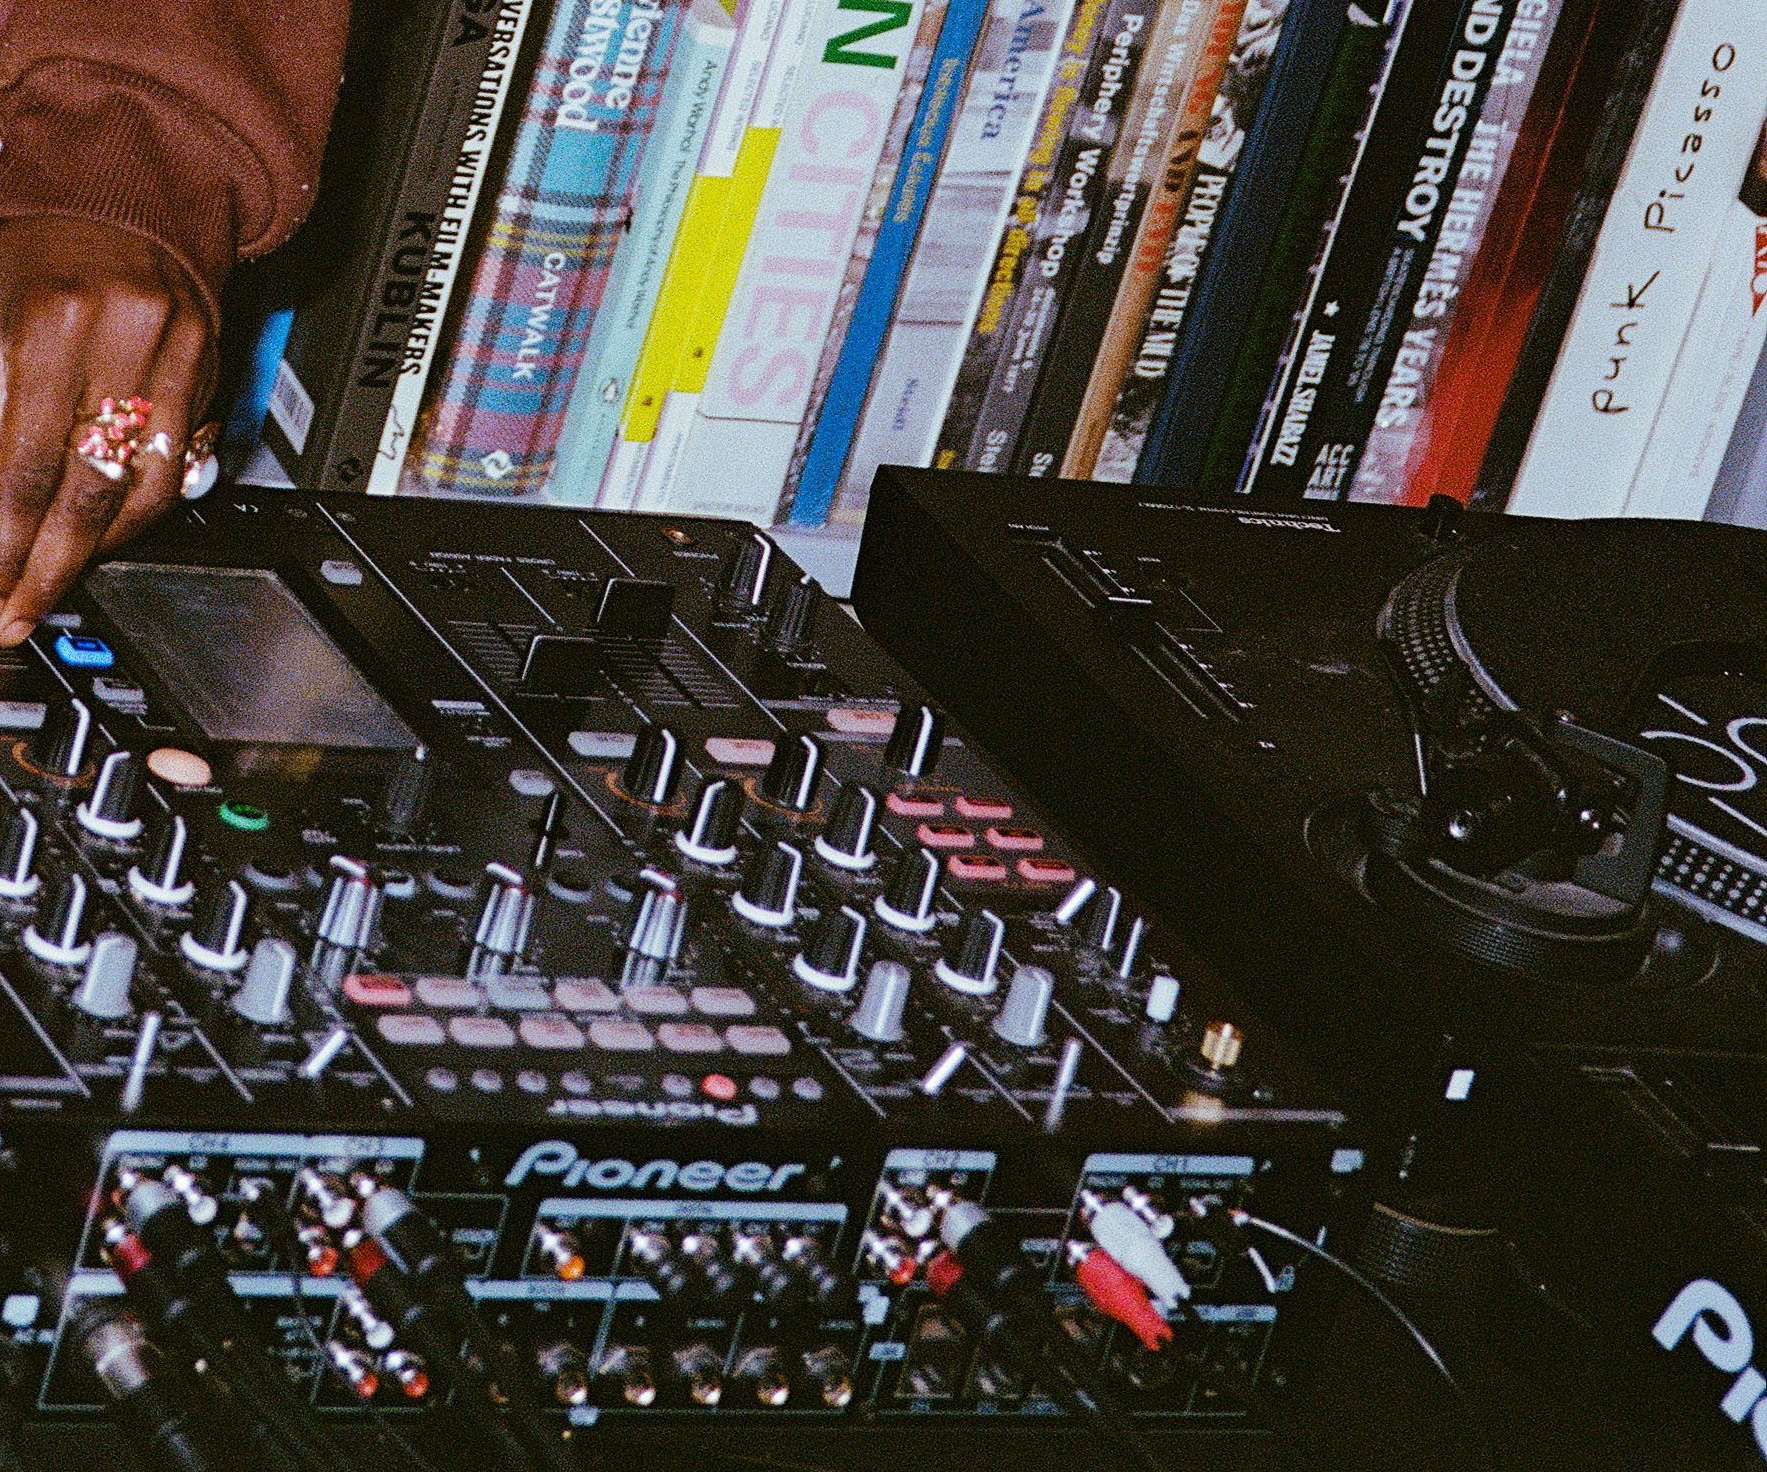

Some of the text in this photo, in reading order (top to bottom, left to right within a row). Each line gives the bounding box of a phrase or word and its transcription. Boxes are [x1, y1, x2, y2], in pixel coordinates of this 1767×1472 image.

[447, 146, 480, 212] WITH
[1037, 12, 1146, 279] Periphery Workshop
[1397, 49, 1487, 242] DESTROY
[1460, 119, 1506, 182] THE
[357, 211, 436, 389] KUBLIN
[399, 212, 462, 380] FILM-MAKERS
[726, 89, 881, 408] CITIES
[1413, 187, 1487, 318] HERMÈS
[511, 251, 566, 379] CATWALK
[1375, 329, 1436, 428] YEARS
[1270, 330, 1336, 466] JAMEL SHABAZZ
[1236, 512, 1341, 535] Technics
[504, 1140, 806, 1193] Pioneer
[547, 1098, 758, 1126] Pioneer
